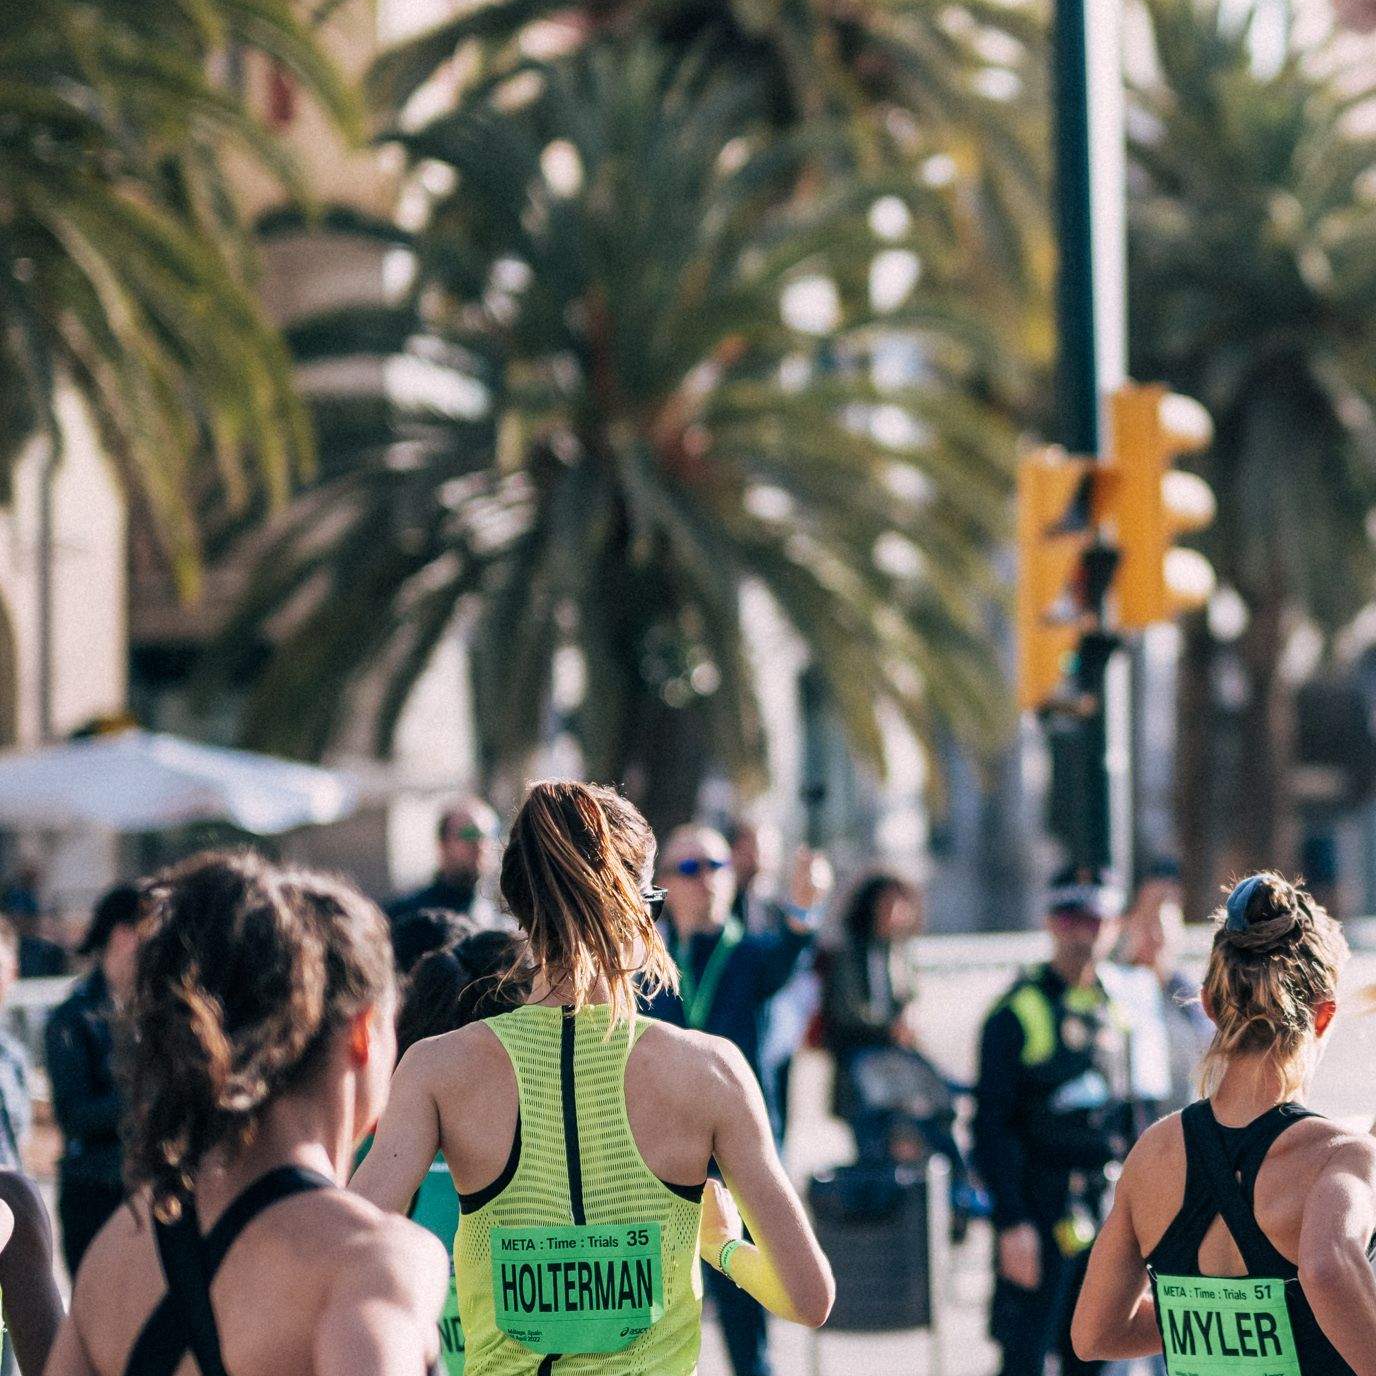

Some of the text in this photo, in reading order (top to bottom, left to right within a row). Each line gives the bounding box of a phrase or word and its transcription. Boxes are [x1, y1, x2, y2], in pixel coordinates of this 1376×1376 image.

[501, 1238, 535, 1251] META
[547, 1236, 577, 1250] Time
[587, 1235, 619, 1249] Trials
[626, 1230, 649, 1247] 35
[501, 1259, 653, 1313] HOLTERMAN
[1163, 1286, 1187, 1297] META
[1194, 1287, 1216, 1300] Time
[1223, 1289, 1247, 1301] Trials
[1254, 1285, 1272, 1300] 51
[1167, 1309, 1283, 1357] MYLER
